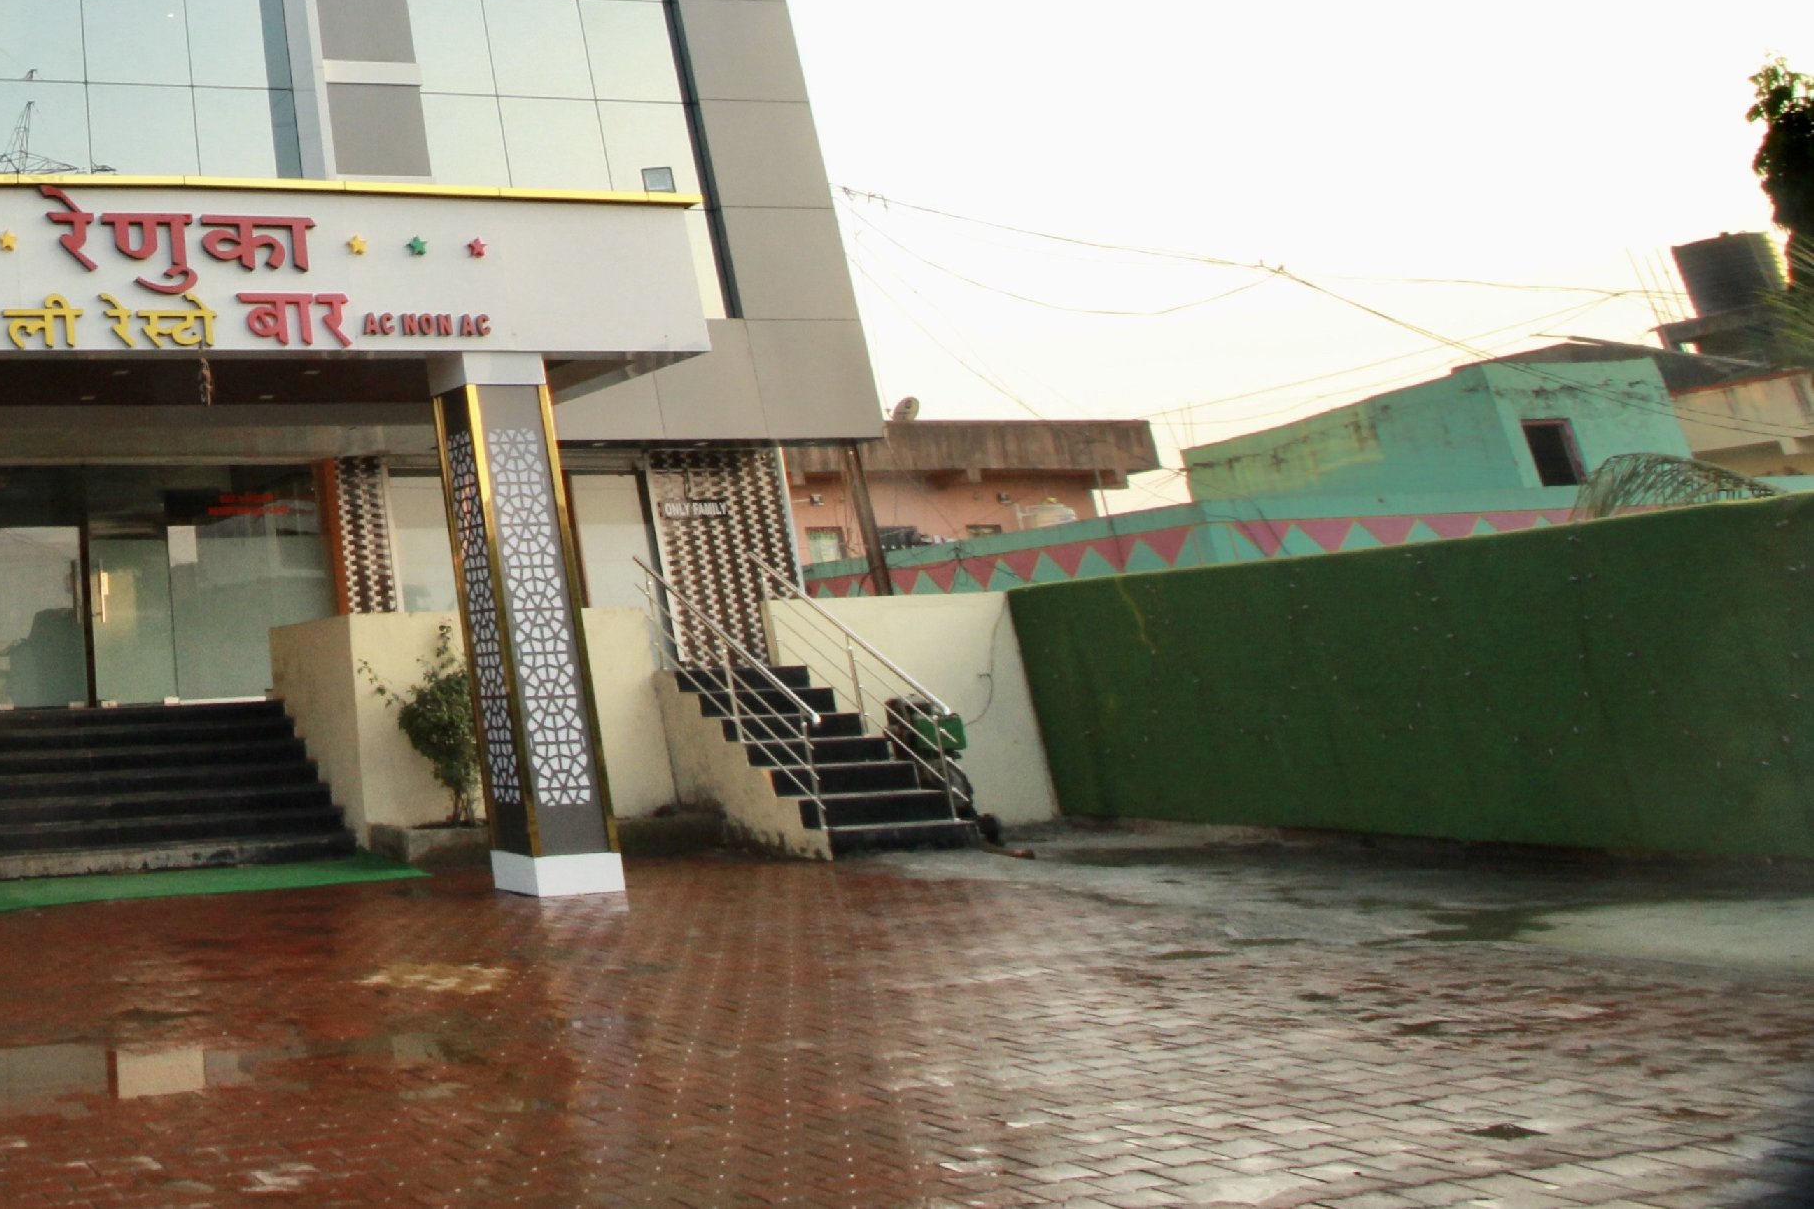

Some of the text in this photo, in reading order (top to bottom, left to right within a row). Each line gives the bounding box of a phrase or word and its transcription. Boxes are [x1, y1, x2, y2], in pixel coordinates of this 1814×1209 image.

[39, 184, 317, 294] रेणुका
[98, 291, 218, 349] रेस्टो
[236, 292, 353, 348] बार
[363, 312, 492, 337] AC NON AC
[664, 502, 728, 516] ONLY FAMILY
